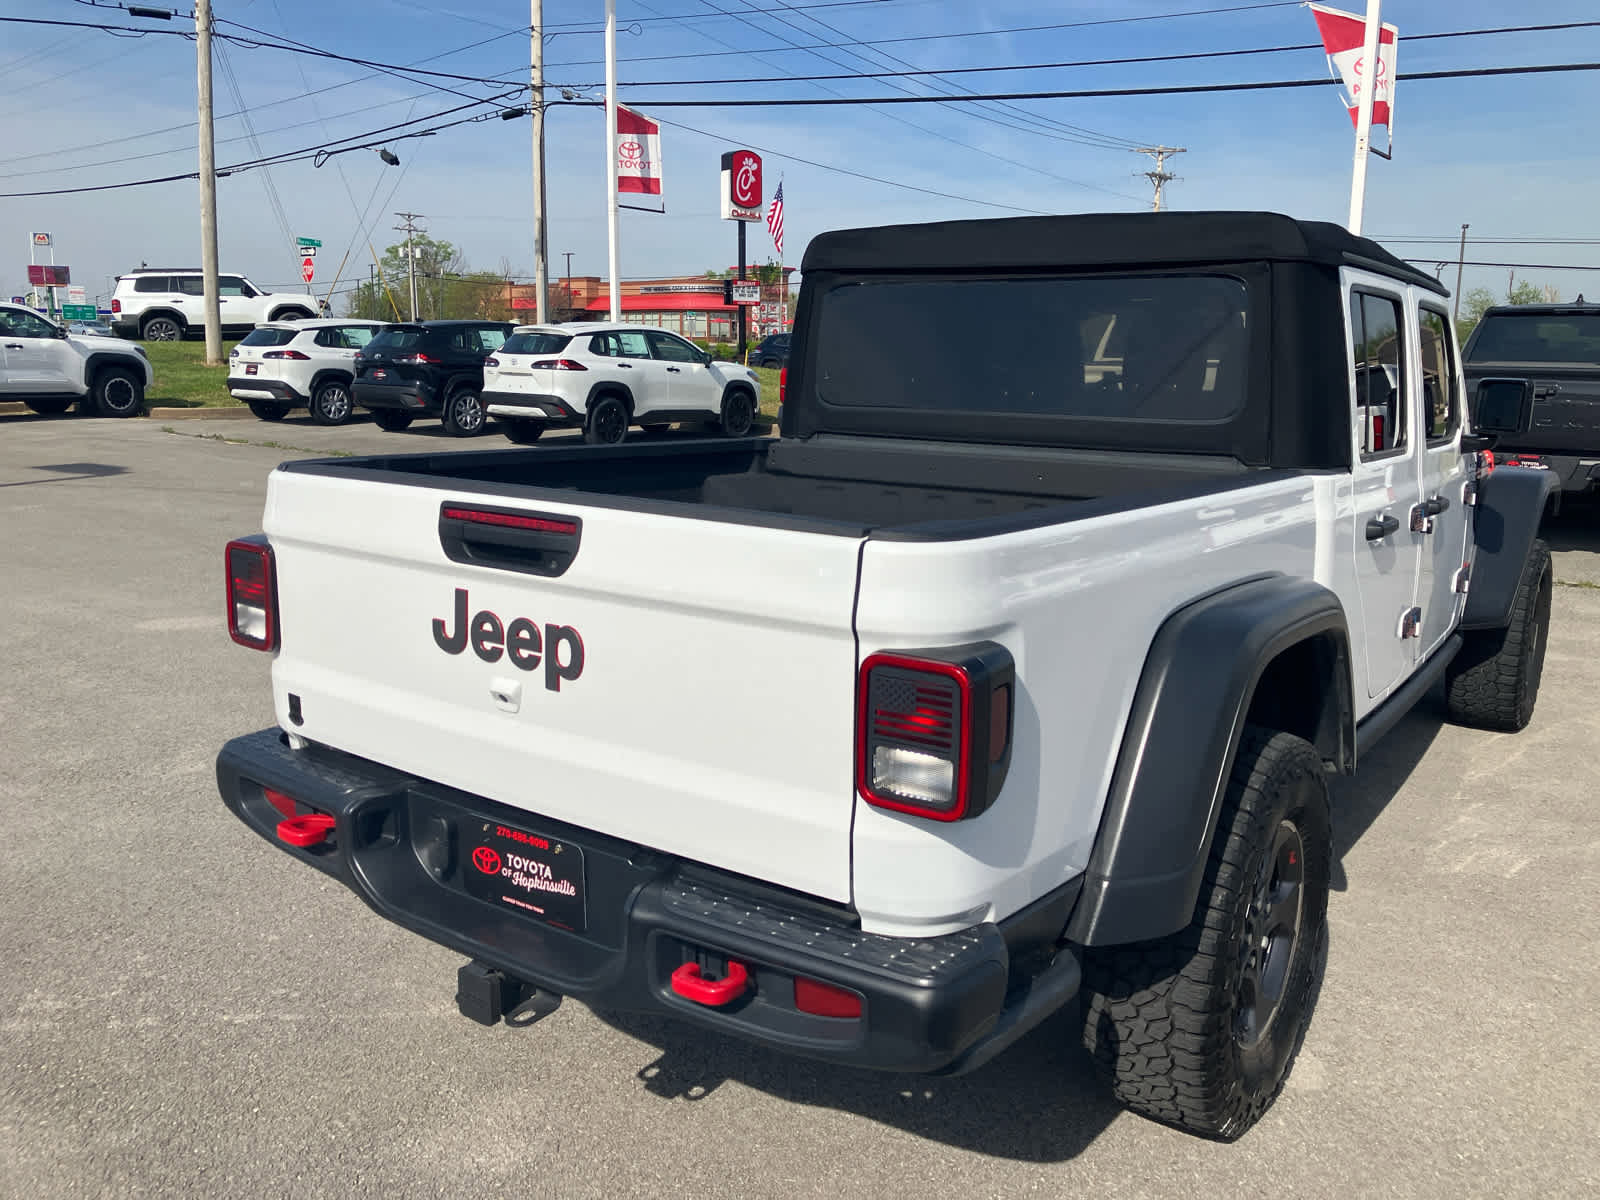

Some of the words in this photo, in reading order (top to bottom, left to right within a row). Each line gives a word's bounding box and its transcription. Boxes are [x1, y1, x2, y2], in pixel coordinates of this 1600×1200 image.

[432, 588, 585, 692] Jeep
[506, 853, 552, 880] TOYOTA
[511, 871, 576, 896] Hopkinsville
